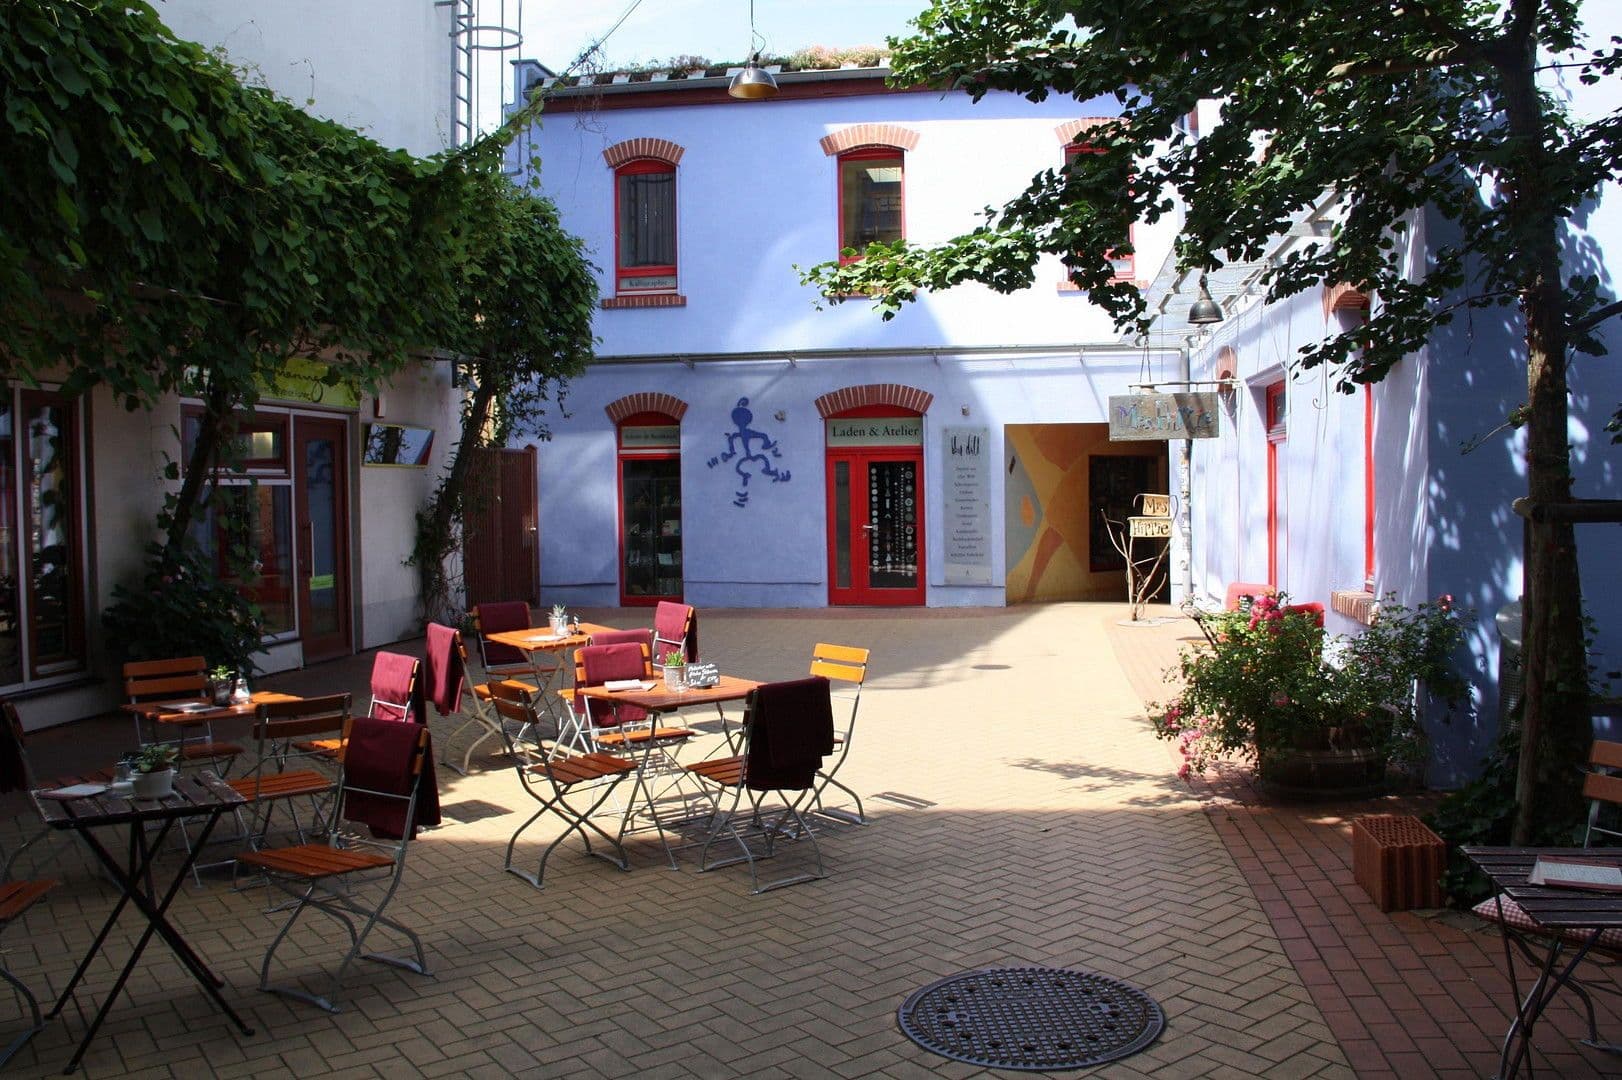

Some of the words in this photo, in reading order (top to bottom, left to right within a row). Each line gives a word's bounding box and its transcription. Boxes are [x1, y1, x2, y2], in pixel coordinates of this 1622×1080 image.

[832, 426, 865, 437] Laden
[869, 426, 880, 437] &
[882, 425, 920, 437] Atelier
[1144, 498, 1168, 514] Mrs
[1133, 521, 1170, 536] Hippie
